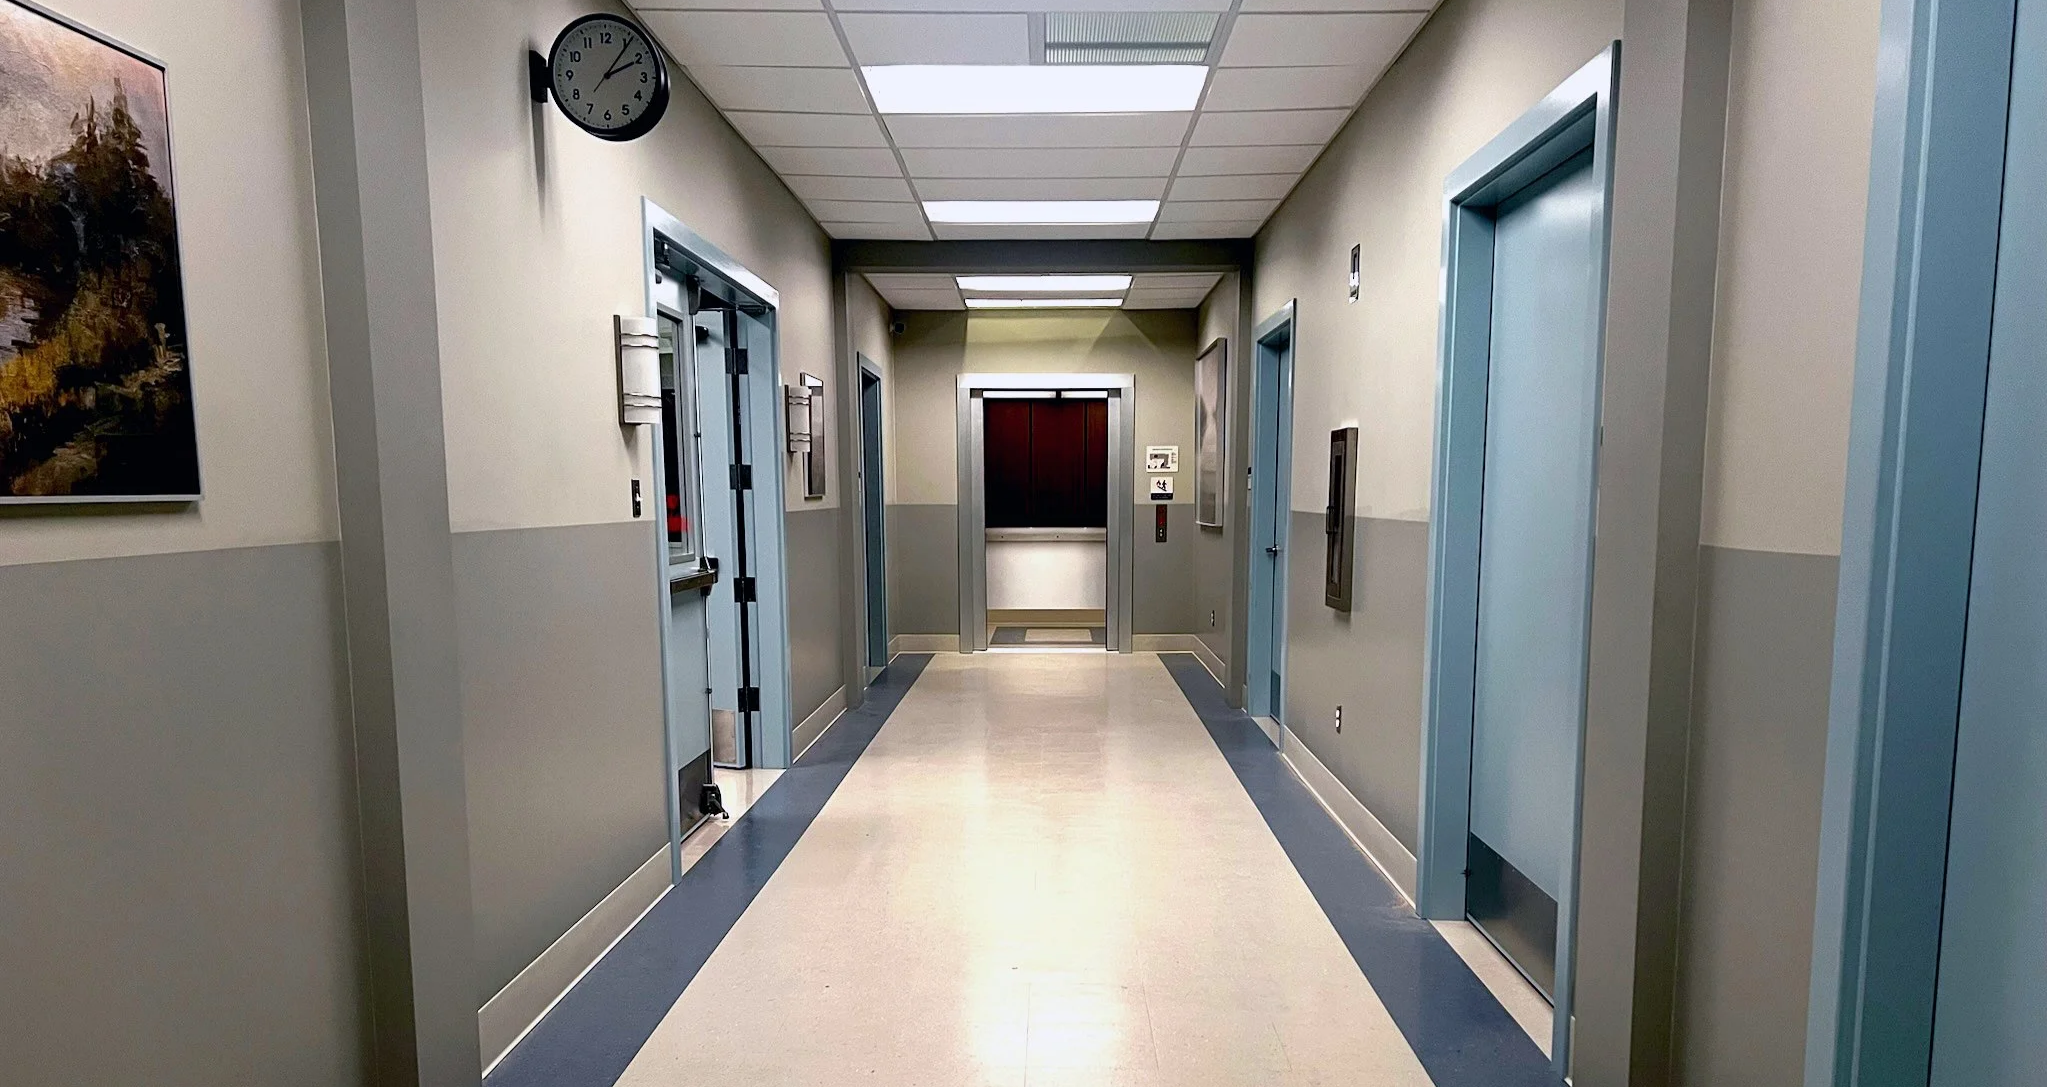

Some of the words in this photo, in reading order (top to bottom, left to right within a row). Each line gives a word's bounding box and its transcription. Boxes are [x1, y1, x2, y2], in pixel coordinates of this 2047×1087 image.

[584, 38, 592, 48] 11
[600, 32, 612, 44] 12
[570, 51, 580, 62] 10
[635, 53, 642, 64] 2
[566, 70, 574, 80] 9
[640, 72, 648, 83] 3
[572, 88, 580, 100] 8
[634, 90, 642, 101] 4
[586, 104, 594, 114] 7
[622, 104, 630, 115] 5
[604, 110, 612, 120] 6
